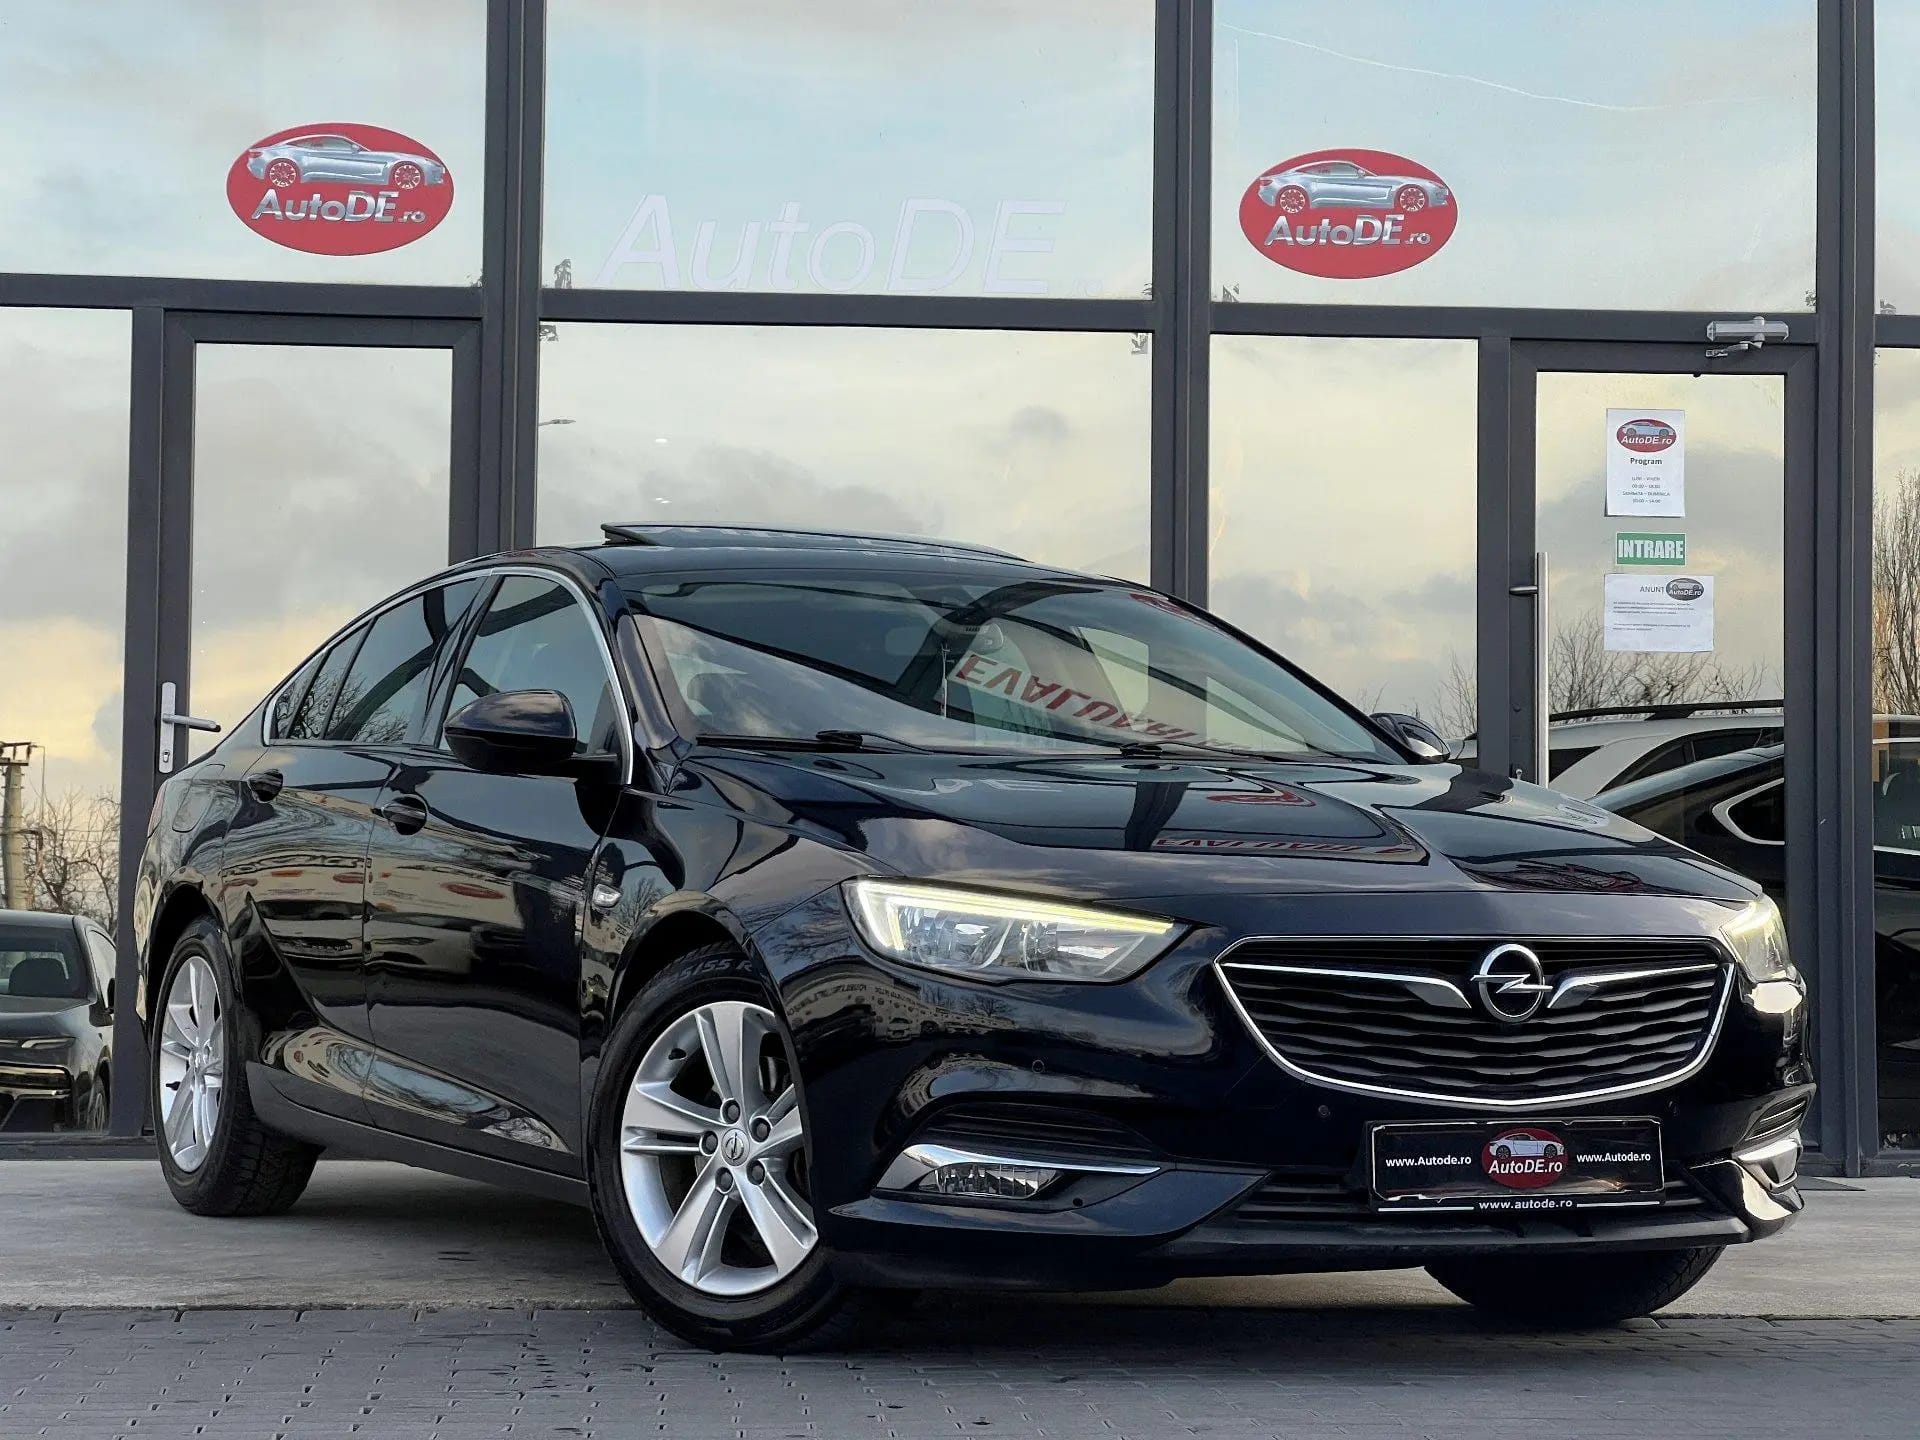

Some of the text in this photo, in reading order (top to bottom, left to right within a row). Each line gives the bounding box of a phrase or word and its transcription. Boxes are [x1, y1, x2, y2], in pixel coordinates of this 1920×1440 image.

[1630, 457, 1663, 466] Program
[1617, 539, 1684, 559] INTRARE
[1385, 1151, 1651, 1175] www.Autode.ro AutoDE.ro www.Autode.ro
[1479, 1198, 1573, 1209] www.autode.ro
